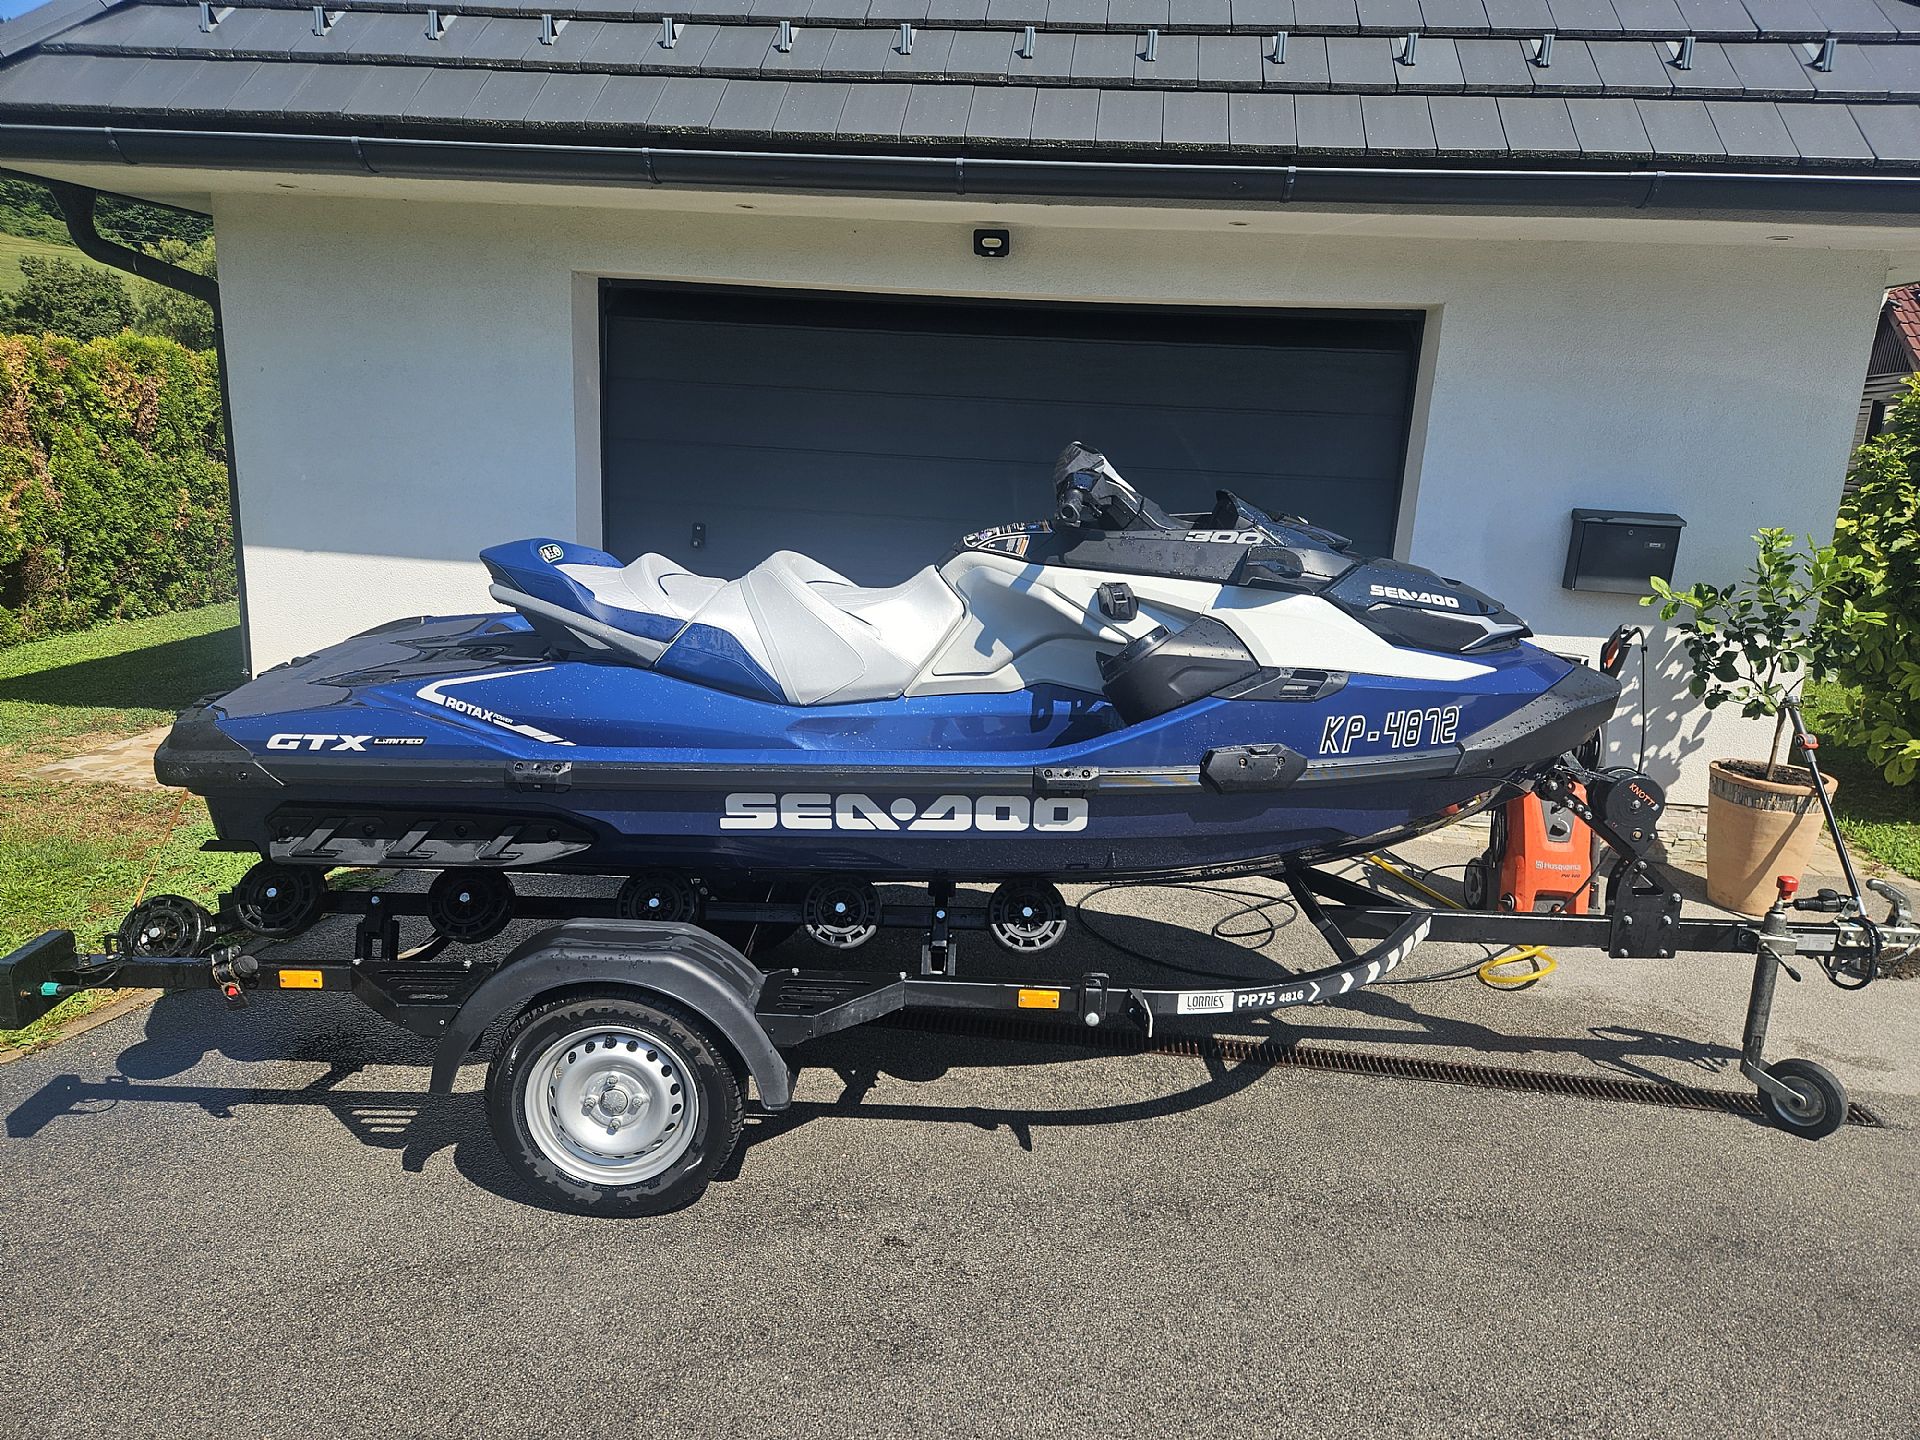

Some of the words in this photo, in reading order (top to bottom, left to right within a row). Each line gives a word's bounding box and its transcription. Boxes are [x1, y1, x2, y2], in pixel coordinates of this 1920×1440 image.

[1185, 531, 1264, 544] 300
[445, 696, 494, 723] ROTAX
[1319, 705, 1460, 754] KP-4872
[266, 733, 374, 751] GTX
[374, 737, 424, 745] LIMITED
[1628, 782, 1656, 806] KNOTT
[1544, 862, 1581, 871] Husqvarna
[1187, 995, 1225, 1008] LORRIES
[1237, 992, 1276, 1008] PP75
[1279, 990, 1304, 1003] 4816
